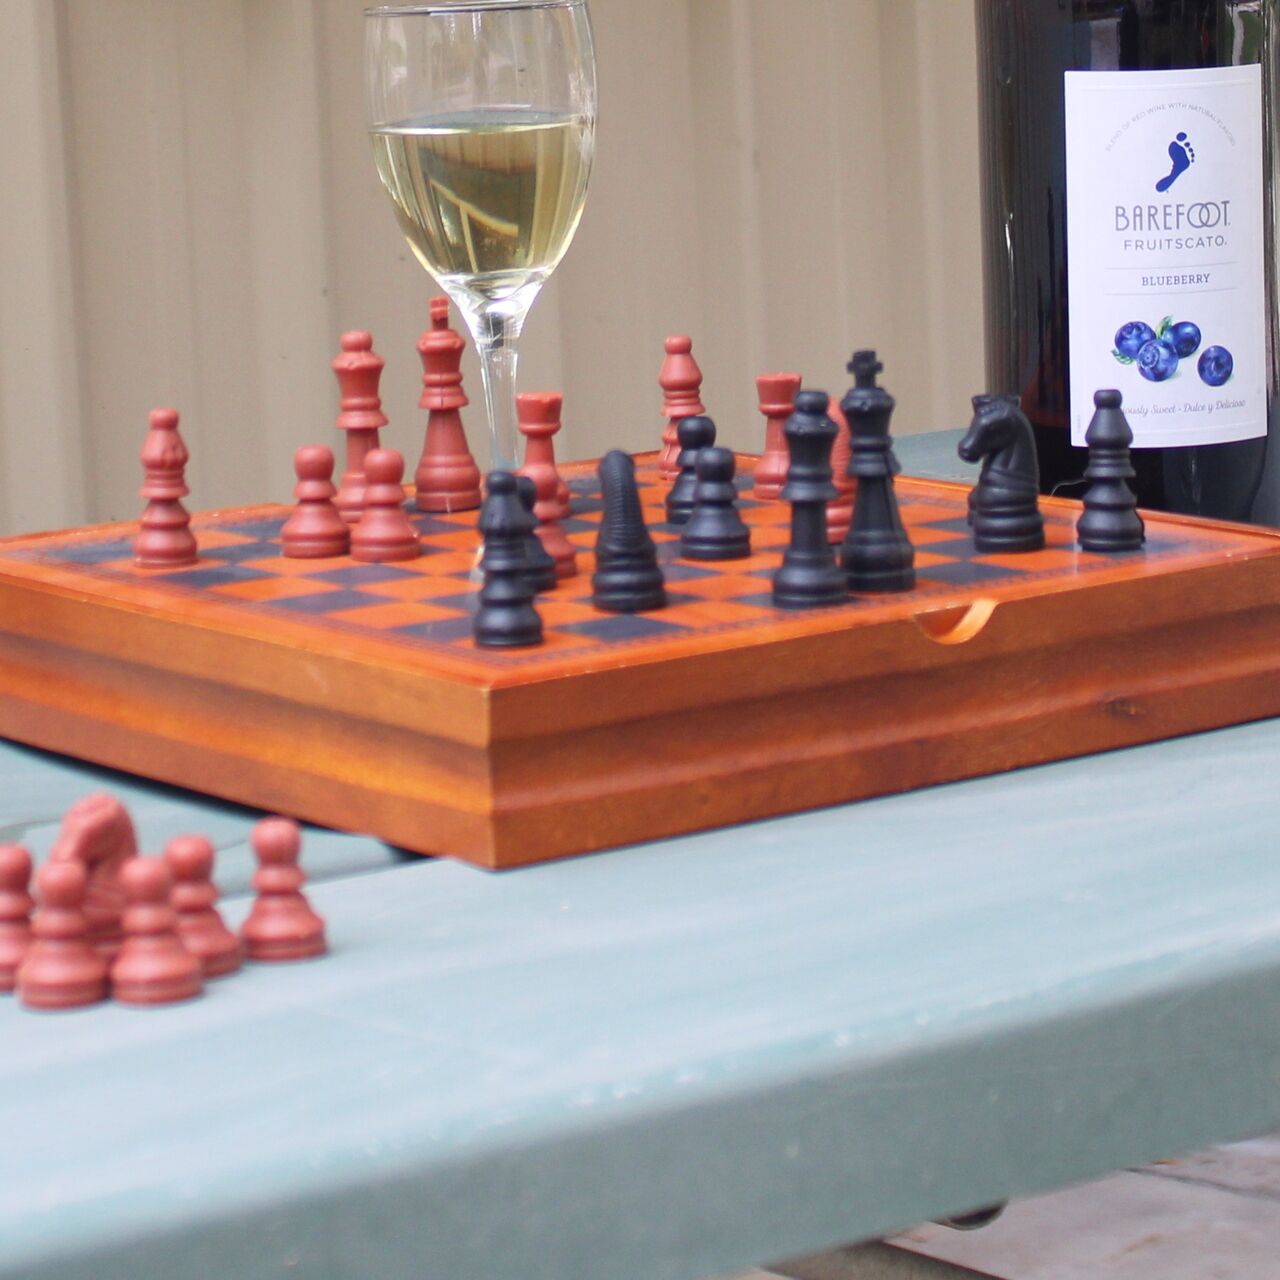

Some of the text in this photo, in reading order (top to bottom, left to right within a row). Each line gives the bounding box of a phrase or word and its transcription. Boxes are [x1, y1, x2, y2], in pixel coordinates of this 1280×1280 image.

[1147, 103, 1166, 115] WINE
[1168, 102, 1188, 110] WITH
[1188, 103, 1218, 122] NATURAL
[1115, 200, 1229, 231] BAREFOOT
[1124, 235, 1225, 250] FRUITSCATO
[1141, 273, 1211, 286] BLUEBERRY
[1150, 404, 1176, 415] Sweet
[1183, 402, 1206, 413] Dulce
